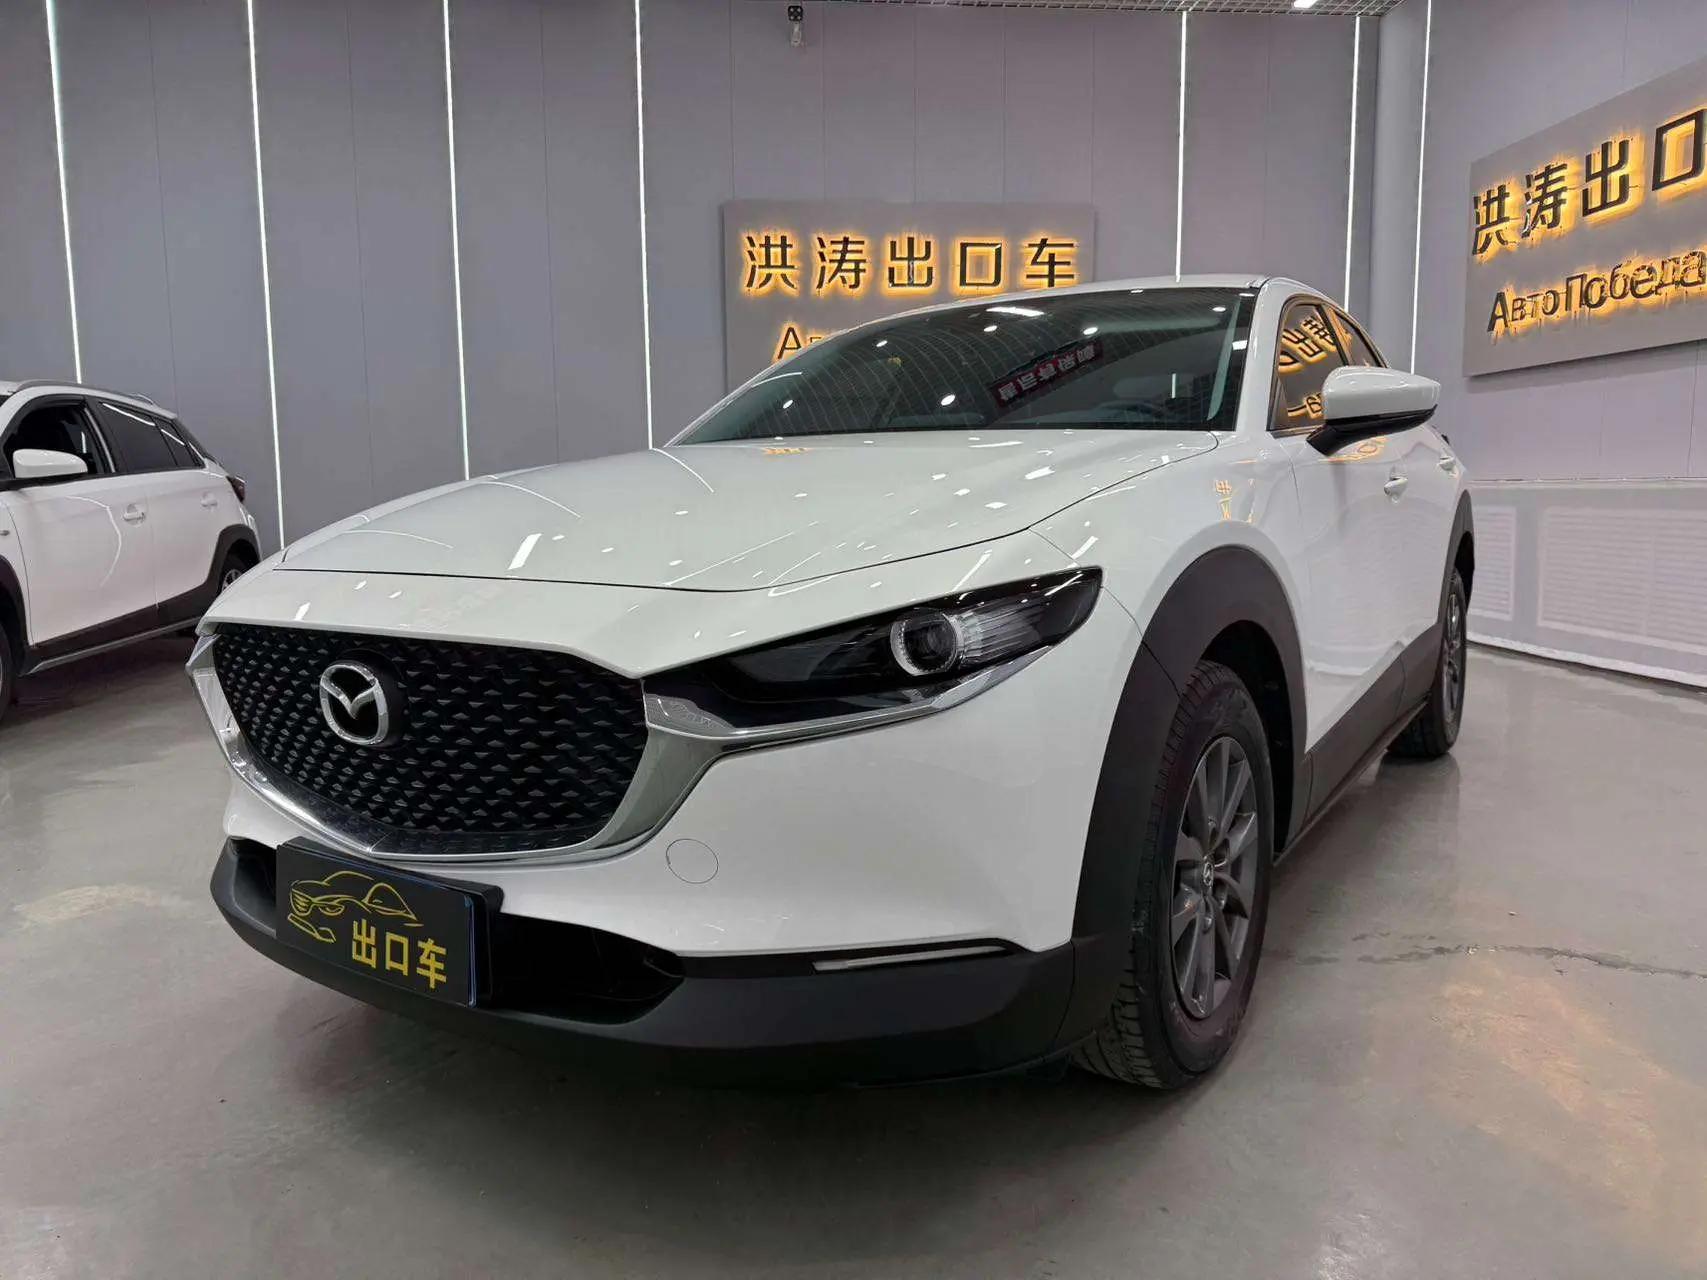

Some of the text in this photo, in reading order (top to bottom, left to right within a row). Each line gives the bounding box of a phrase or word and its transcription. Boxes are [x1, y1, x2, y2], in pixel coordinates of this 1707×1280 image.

[1472, 109, 1706, 256] 洪涛出口
[745, 235, 1075, 289] 洪涛出口车
[1487, 251, 1707, 332] АвтоПобеда
[352, 919, 447, 989] 出口车
